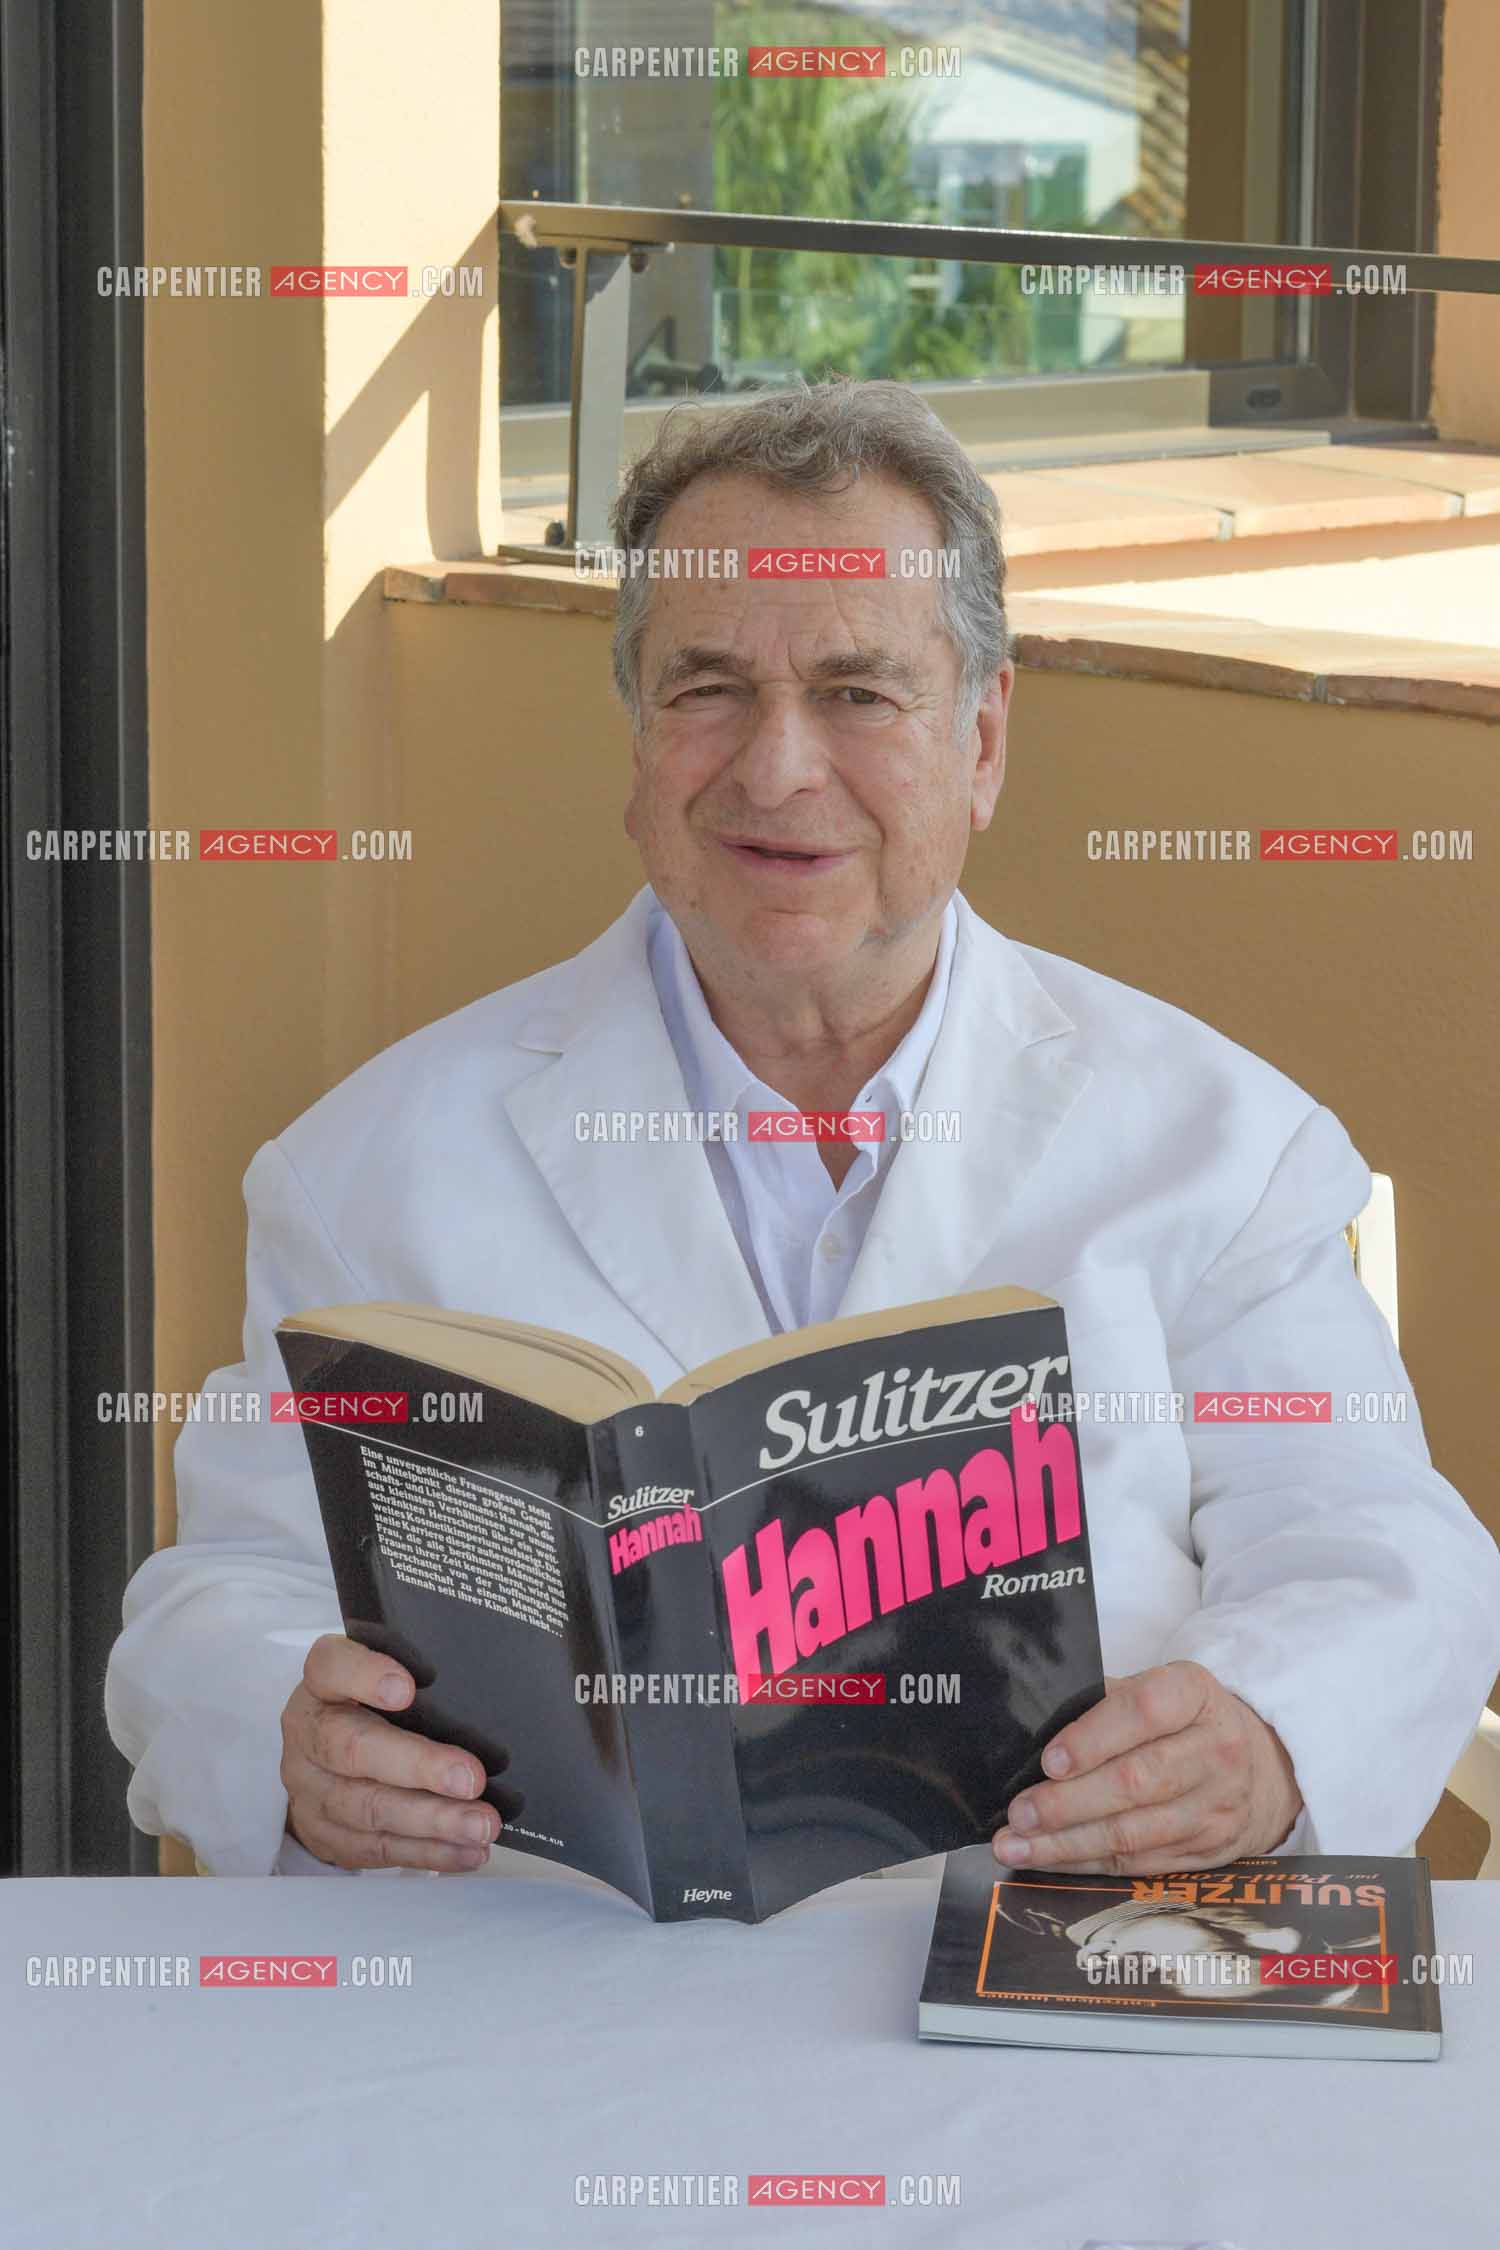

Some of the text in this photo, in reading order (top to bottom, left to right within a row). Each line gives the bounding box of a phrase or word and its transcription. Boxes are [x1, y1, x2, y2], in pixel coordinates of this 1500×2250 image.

[634, 1425, 645, 1438] 6
[759, 1355, 1069, 1470] Sulitzer
[360, 1445, 383, 1460] Eine
[459, 1476, 526, 1509] Frauengestalt
[528, 1504, 551, 1520] steht
[366, 1470, 555, 1543] schafts- und Liebesromans: Hannah, die
[368, 1481, 385, 1492] aus
[388, 1486, 435, 1507] kleinsten
[438, 1501, 506, 1532] Verhältnissen
[509, 1528, 525, 1539] zur
[381, 1462, 440, 1488] Mittelpunkt
[446, 1484, 477, 1501] dieses
[482, 1497, 516, 1516] großen
[607, 1485, 695, 1519] Sulitzer
[370, 1492, 425, 1515] schränkten
[428, 1508, 488, 1536] Herrscherin
[491, 1529, 514, 1545] über
[517, 1541, 532, 1553] ein
[372, 1502, 405, 1519] weites
[406, 1511, 501, 1551] Kosmetikimperium
[545, 1561, 561, 1576] Die
[374, 1513, 401, 1528] steile
[401, 1520, 445, 1542] Karriere
[445, 1536, 476, 1552] dieser
[608, 1503, 703, 1575] Hannah
[722, 1399, 1082, 1706] Hannah
[376, 1522, 565, 1599] Frau, die alle berühmten Männer und
[378, 1533, 413, 1553] Frauen
[415, 1545, 441, 1561] ihrer
[441, 1553, 462, 1568] Zeit
[527, 1585, 550, 1601] wird
[551, 1596, 567, 1610] nur
[380, 1544, 569, 1621] überschattet von der hoffnungslosen
[390, 1558, 564, 1628] Leidenschaft zu einem Mann, den
[980, 1565, 1086, 1600] Roman
[396, 1570, 436, 1591] Hannah
[437, 1585, 456, 1598] seit
[457, 1590, 483, 1605] ihrer
[484, 1598, 528, 1622] Kindheit
[682, 1888, 733, 1904] Heyne
[1130, 1880, 1387, 1907] SULITZER
